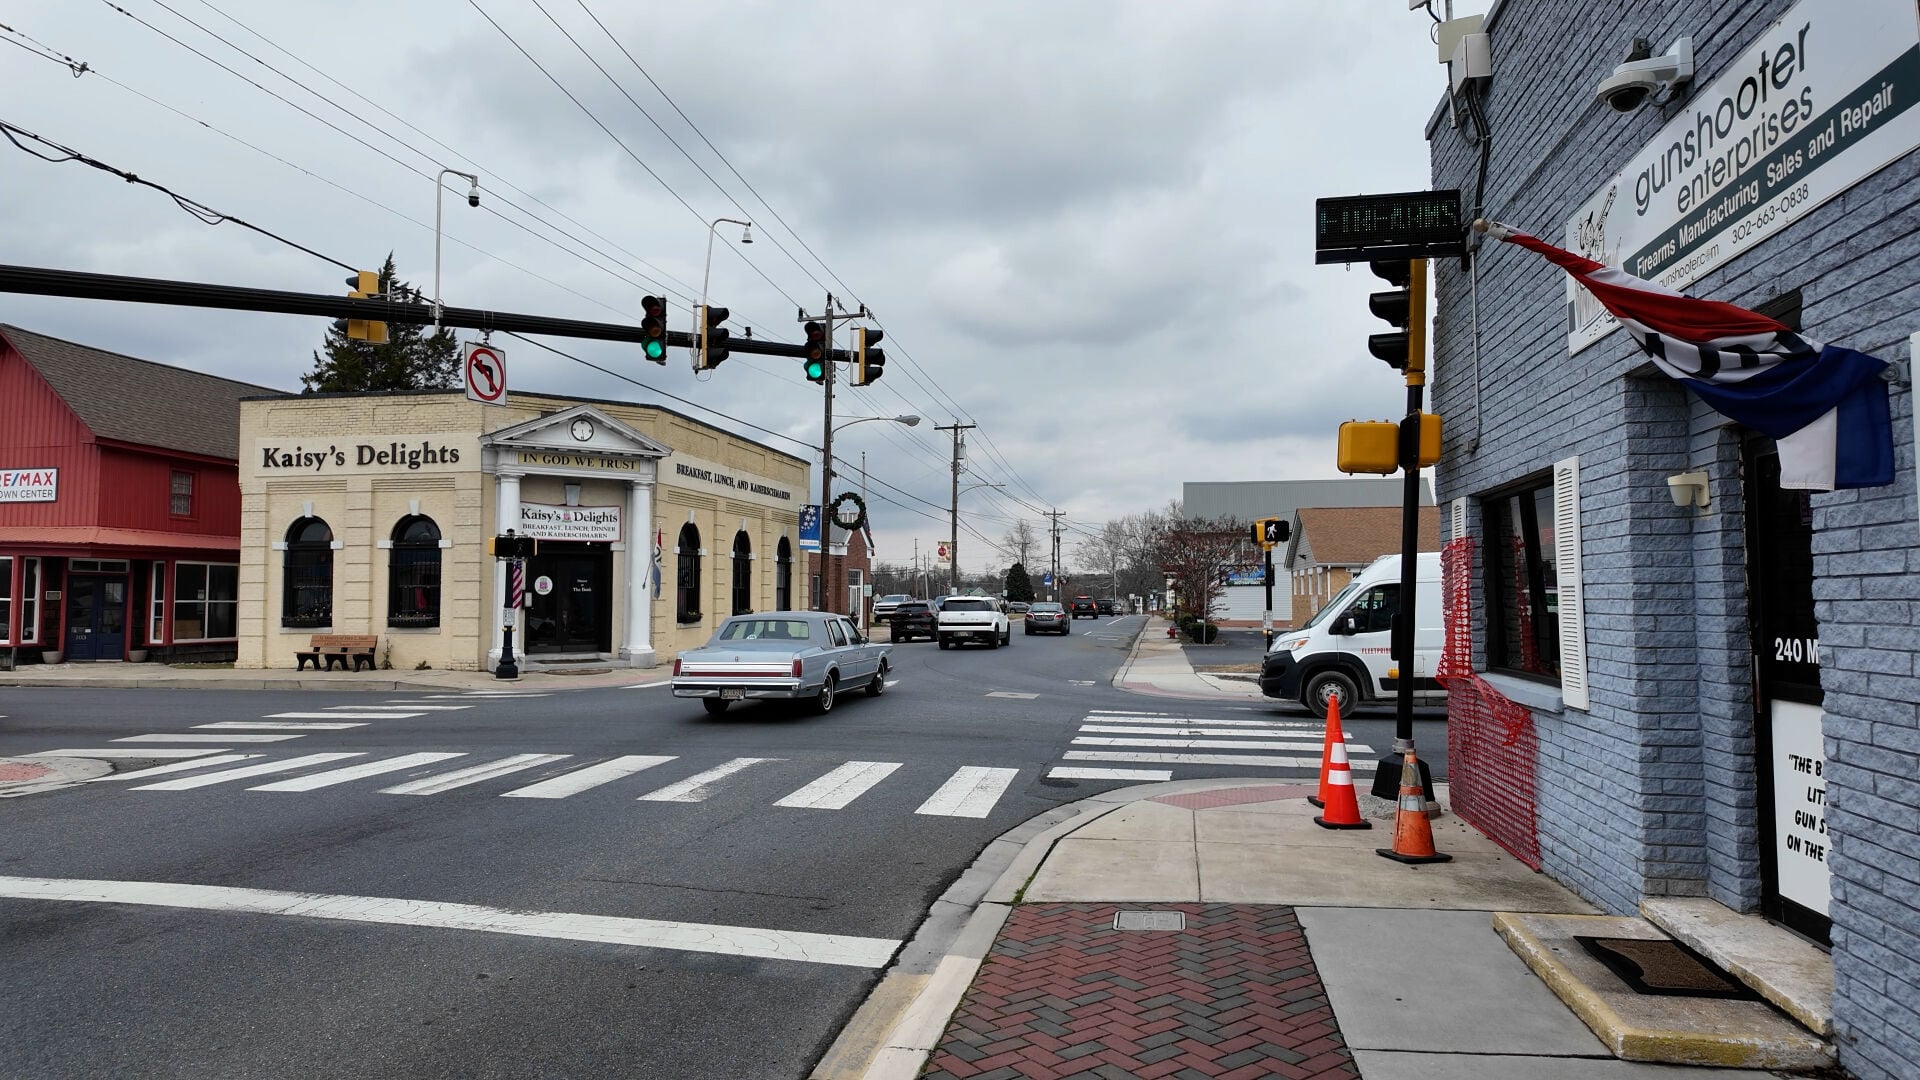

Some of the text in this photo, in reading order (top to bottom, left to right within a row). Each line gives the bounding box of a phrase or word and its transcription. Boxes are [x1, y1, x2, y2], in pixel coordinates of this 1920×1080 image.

[1636, 22, 1810, 217] gunshooter
[1677, 85, 1813, 214] enterprises
[1636, 81, 1894, 278] Firearms Manufacturing Sales and Repair
[1732, 183, 1809, 244] 302-663-0838
[263, 441, 460, 471] Kaisy's Delights
[523, 453, 636, 469] IN GOD WE TRUST
[0, 471, 53, 487] E/MAX
[676, 463, 713, 484] BREAKFAST,
[714, 473, 736, 489] LUNCH,
[737, 480, 749, 490] AND
[20, 489, 54, 499] CENTER
[521, 508, 618, 524] Kaisy's Delights
[1775, 637, 1819, 664] 240 M
[1807, 786, 1826, 806] LIT
[1795, 809, 1816, 831] GUN
[1787, 834, 1825, 862] ON THE
